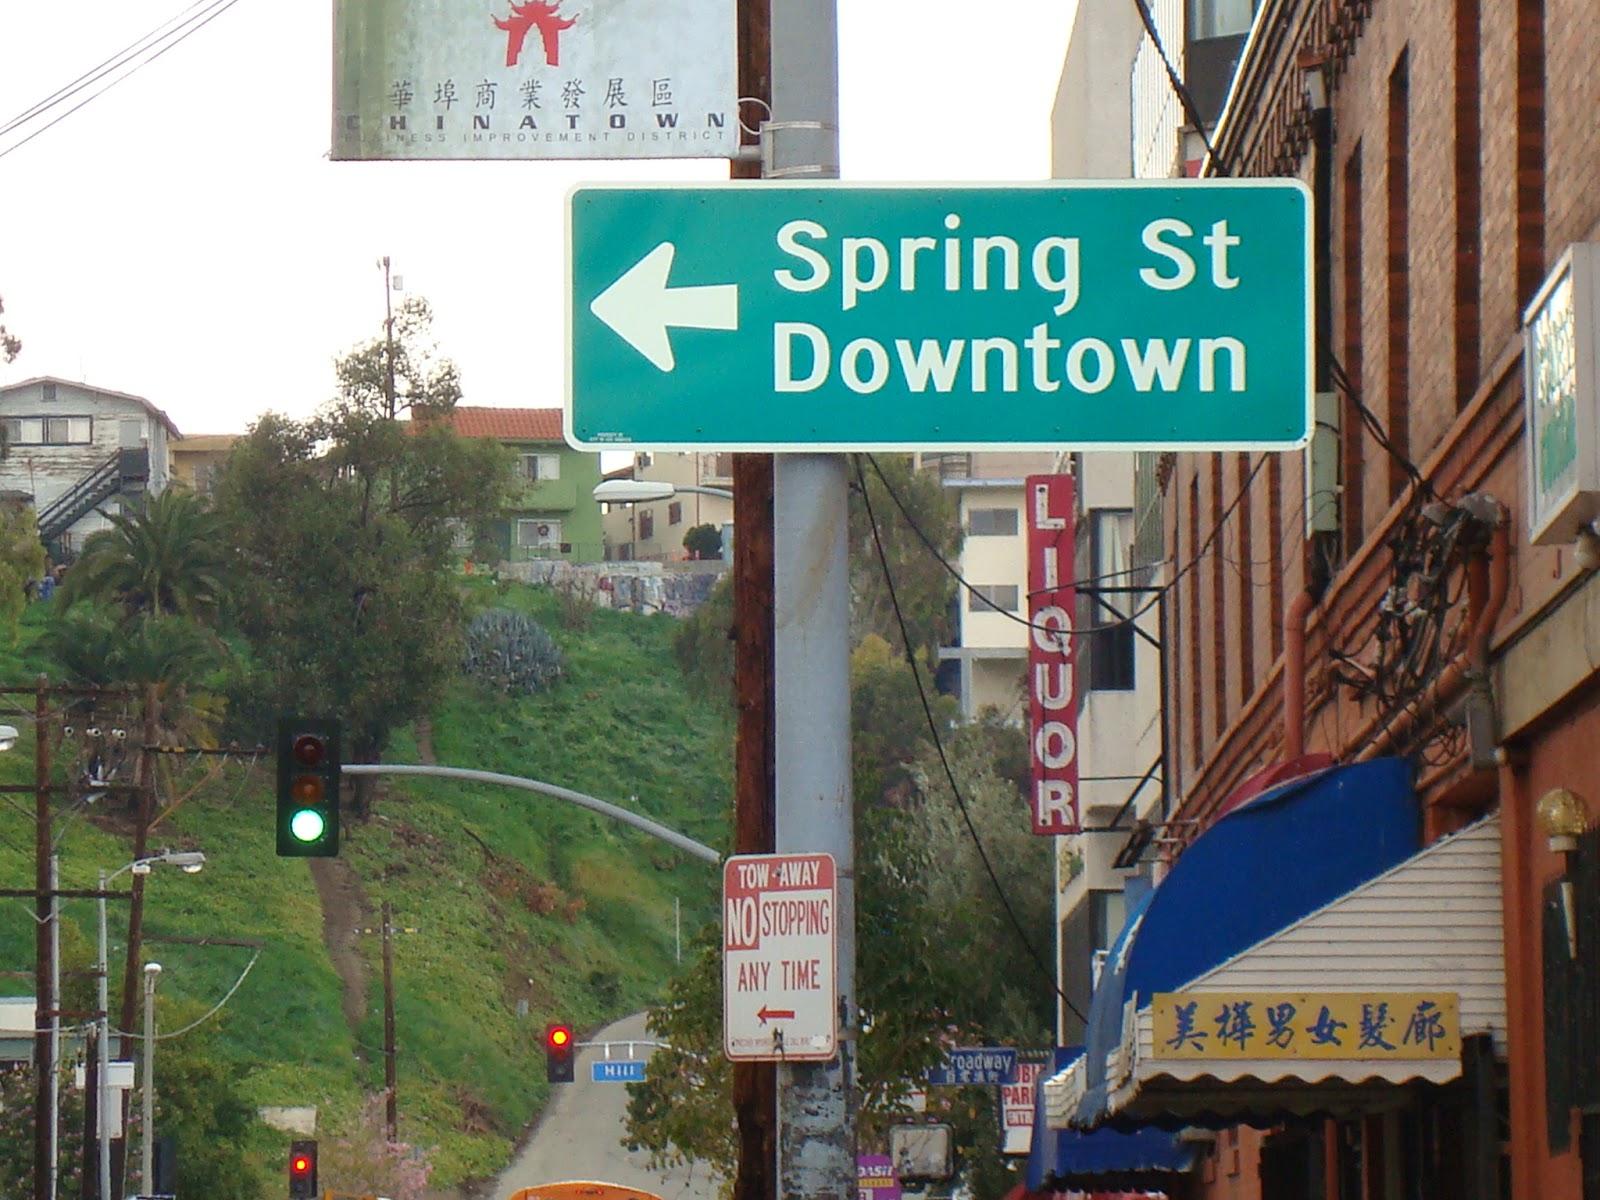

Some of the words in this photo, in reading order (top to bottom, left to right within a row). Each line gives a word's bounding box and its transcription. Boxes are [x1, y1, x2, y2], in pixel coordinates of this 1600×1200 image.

[388, 78, 673, 110] 華埠商業發展區
[346, 113, 725, 130] CHINATOWN
[464, 132, 610, 143] IMPROVEMENT
[627, 131, 725, 142] DISTRICT
[774, 213, 1080, 315] Spring
[1139, 218, 1241, 290] St
[774, 322, 1246, 394] Downtown
[1032, 484, 1076, 826] LIQUOR
[727, 896, 758, 946] NO
[762, 899, 829, 937] STOPPING
[738, 961, 771, 992] ANY
[781, 959, 821, 990] TIME
